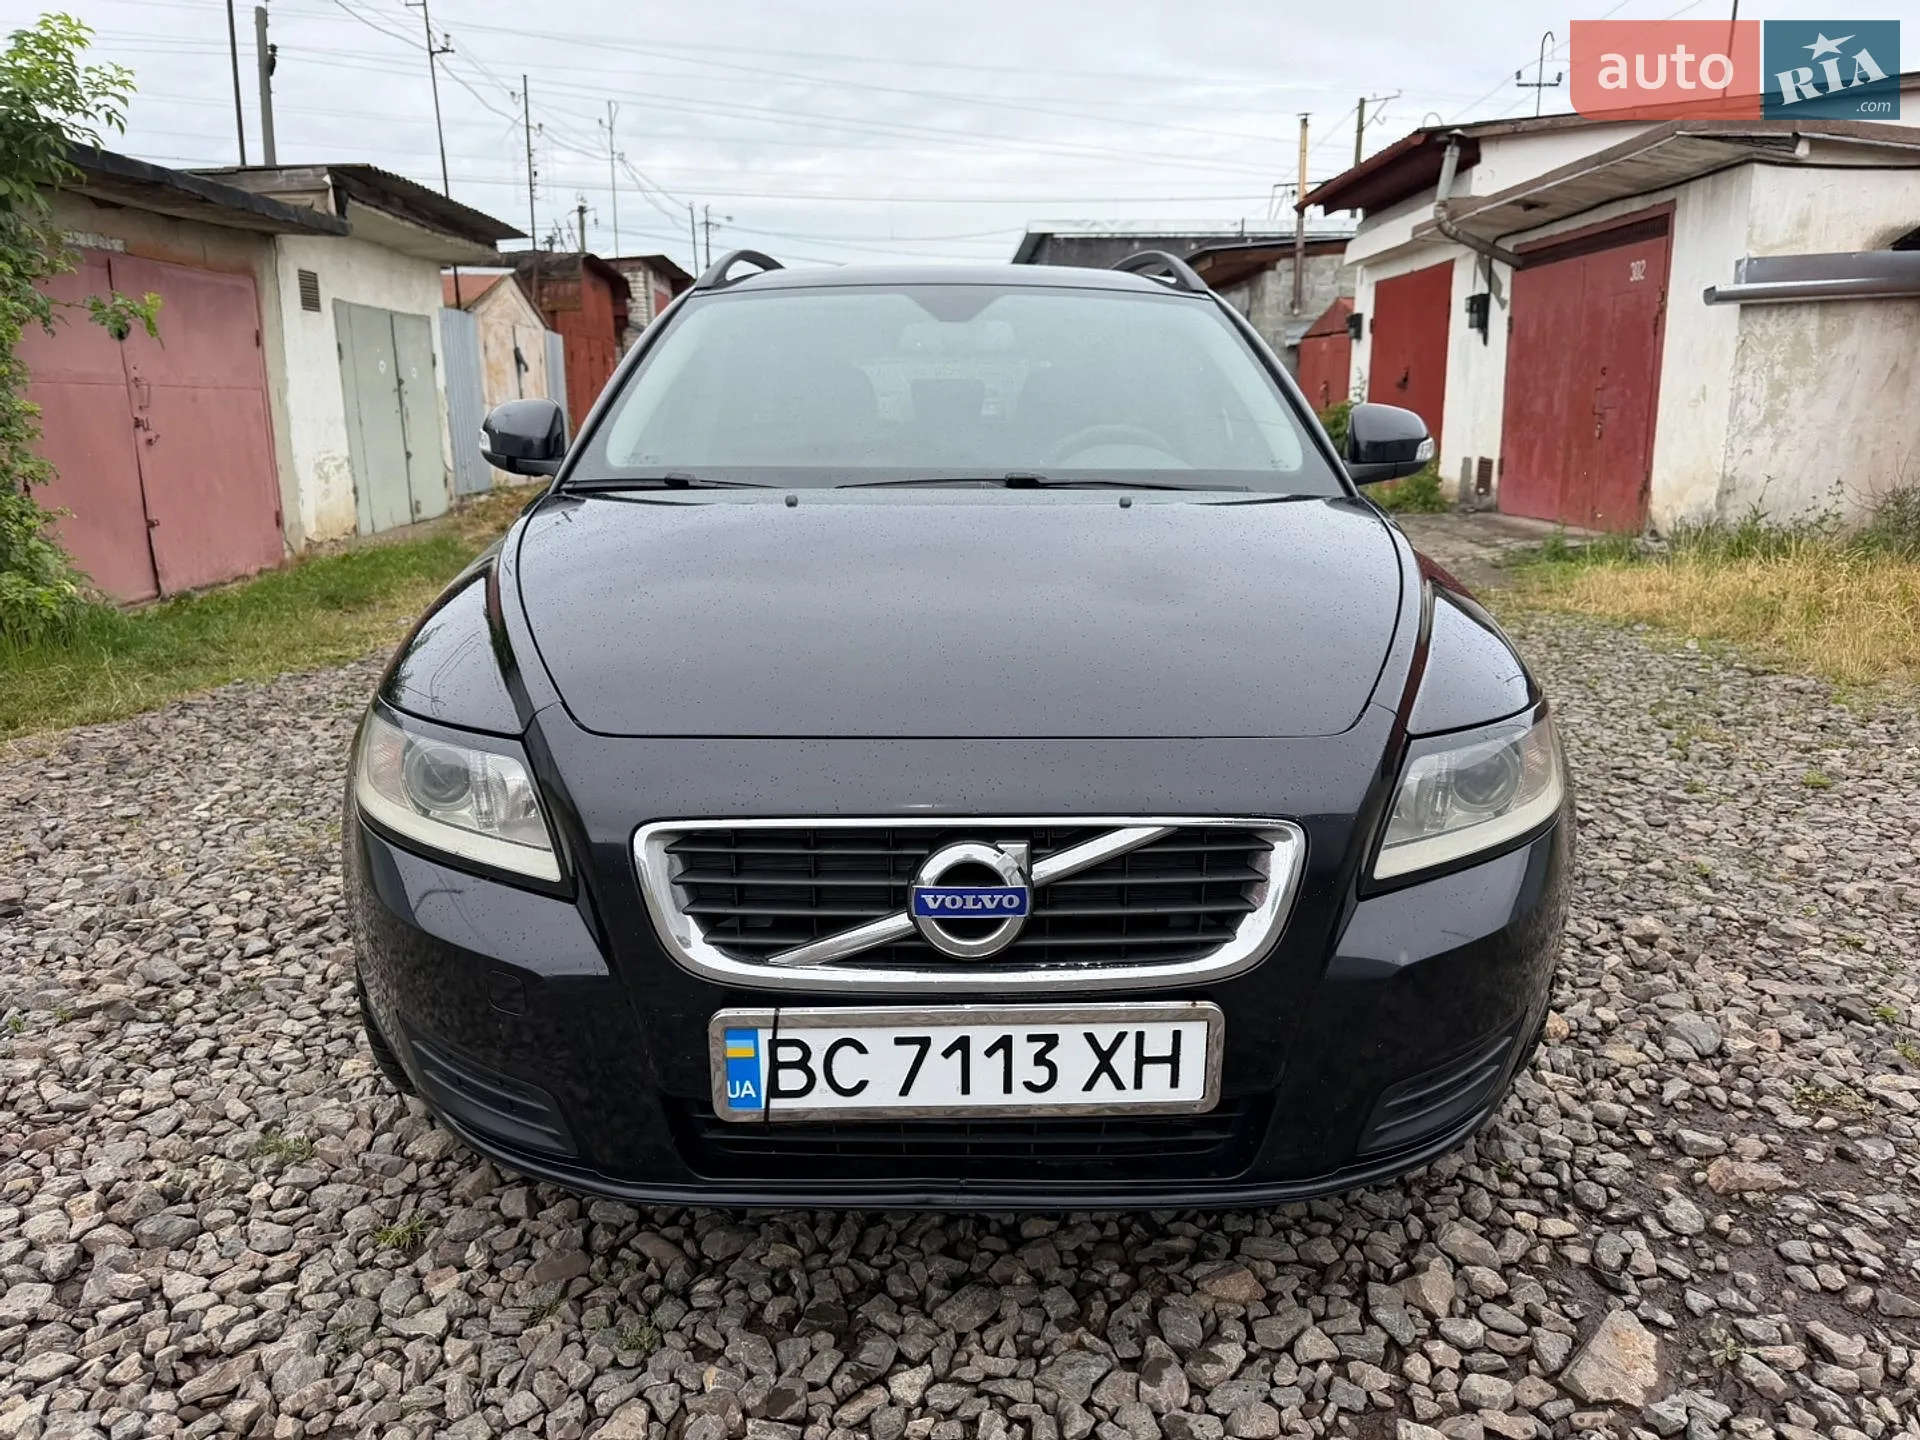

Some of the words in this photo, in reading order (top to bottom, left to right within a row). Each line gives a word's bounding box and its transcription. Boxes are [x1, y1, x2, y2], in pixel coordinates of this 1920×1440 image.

[920, 894, 1020, 910] VOLVO
[767, 1037, 869, 1098] BC
[893, 1033, 1060, 1097] 7113
[1081, 1030, 1182, 1092] XH
[727, 1079, 757, 1099] UA
